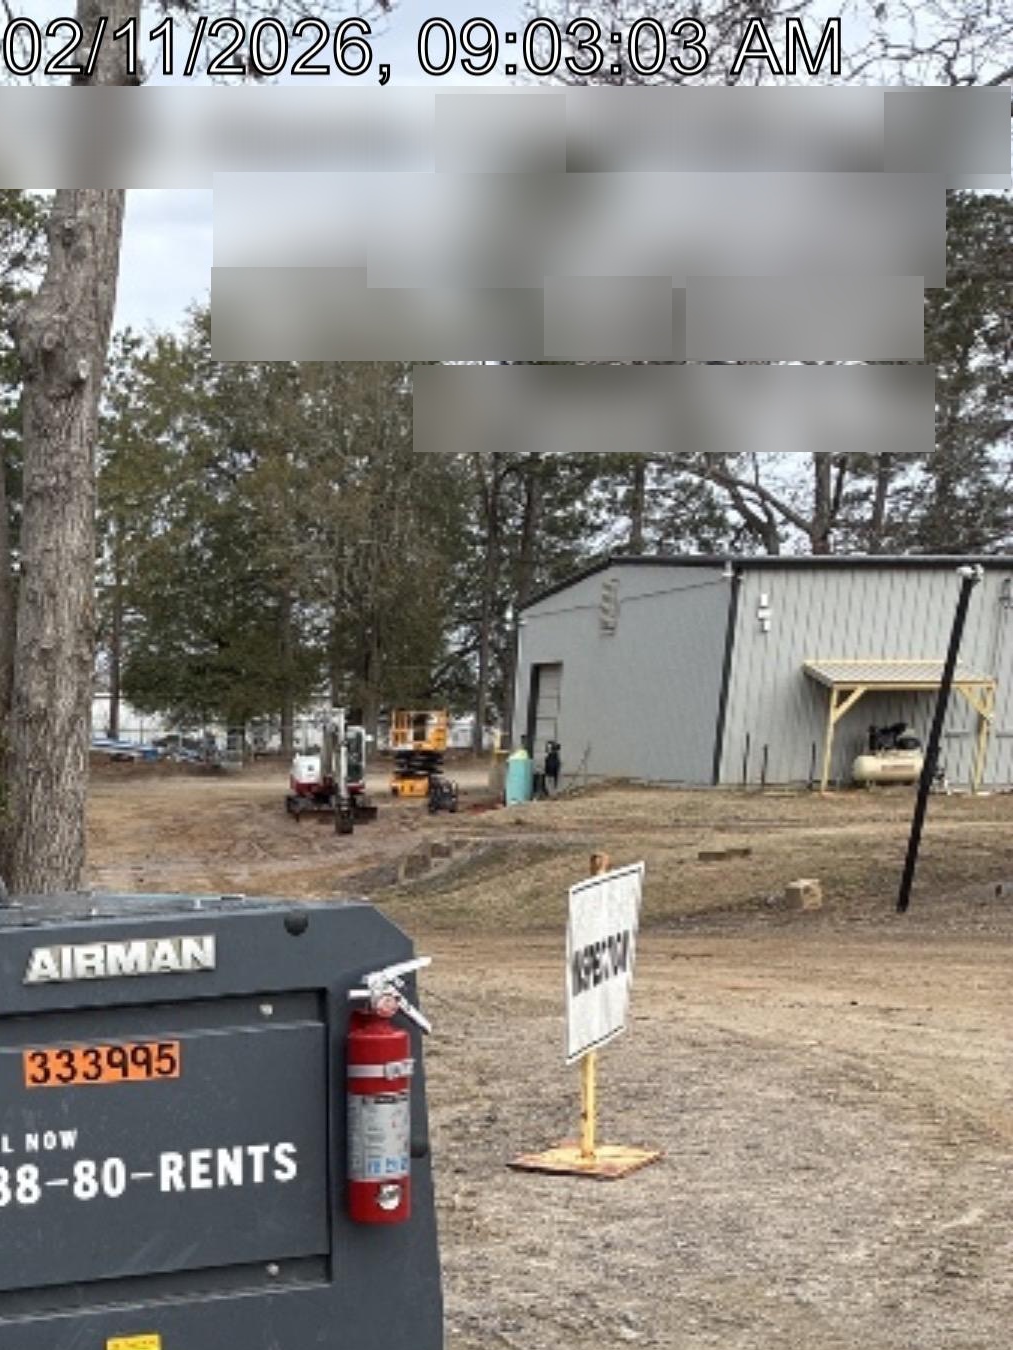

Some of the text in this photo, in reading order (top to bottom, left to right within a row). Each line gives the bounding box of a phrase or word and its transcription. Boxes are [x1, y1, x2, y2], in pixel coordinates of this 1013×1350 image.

[23, 935, 216, 984] AIRMAN
[28, 1044, 177, 1085] 333995
[25, 1129, 78, 1151] NOW
